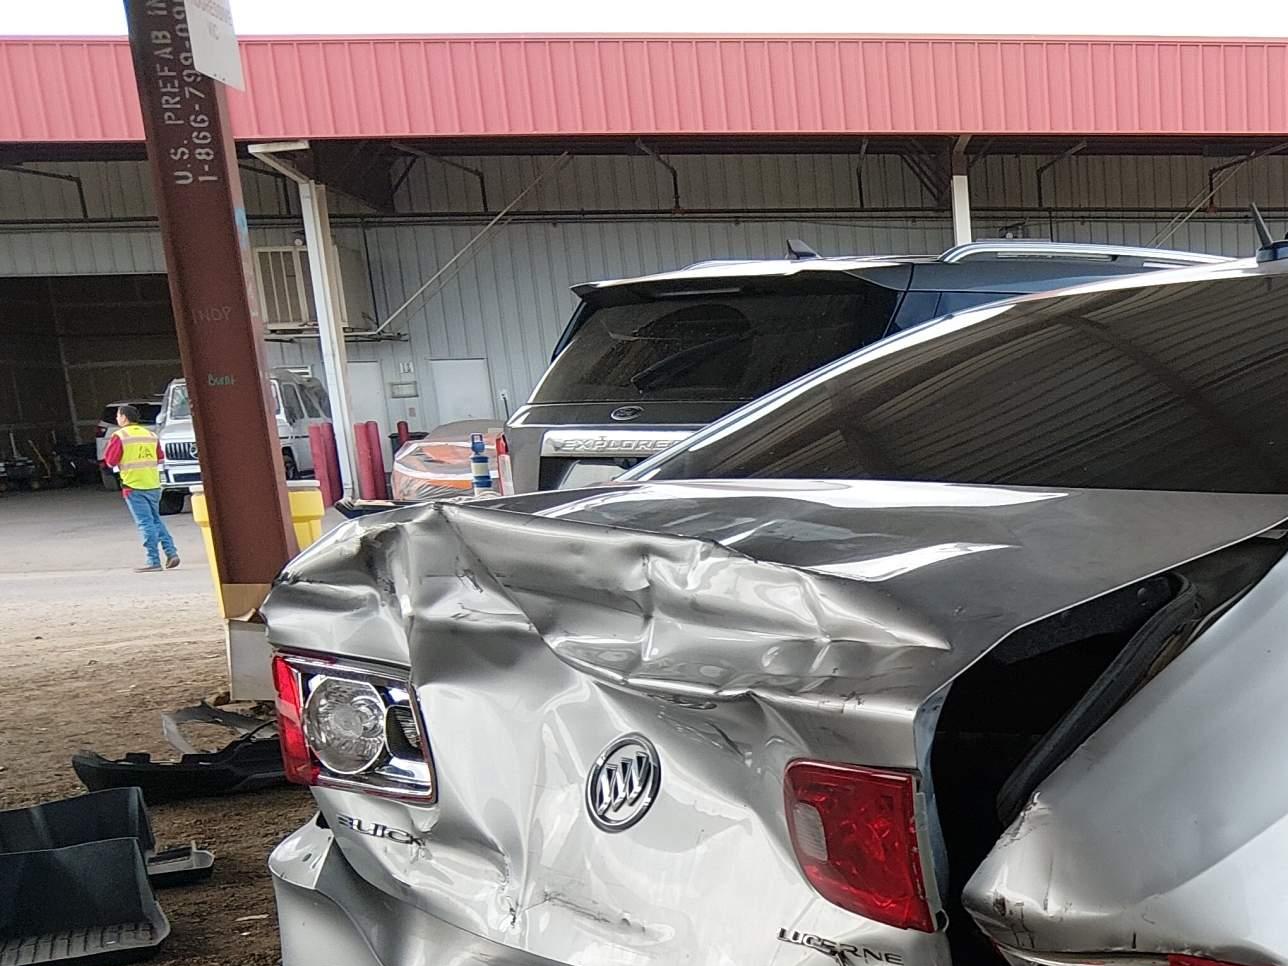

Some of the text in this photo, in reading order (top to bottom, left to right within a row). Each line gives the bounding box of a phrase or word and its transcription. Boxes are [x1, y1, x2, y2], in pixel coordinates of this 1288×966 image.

[150, 30, 185, 124] PREFAB
[169, 140, 193, 185] U.S.
[777, 927, 905, 966] LUCERNE
